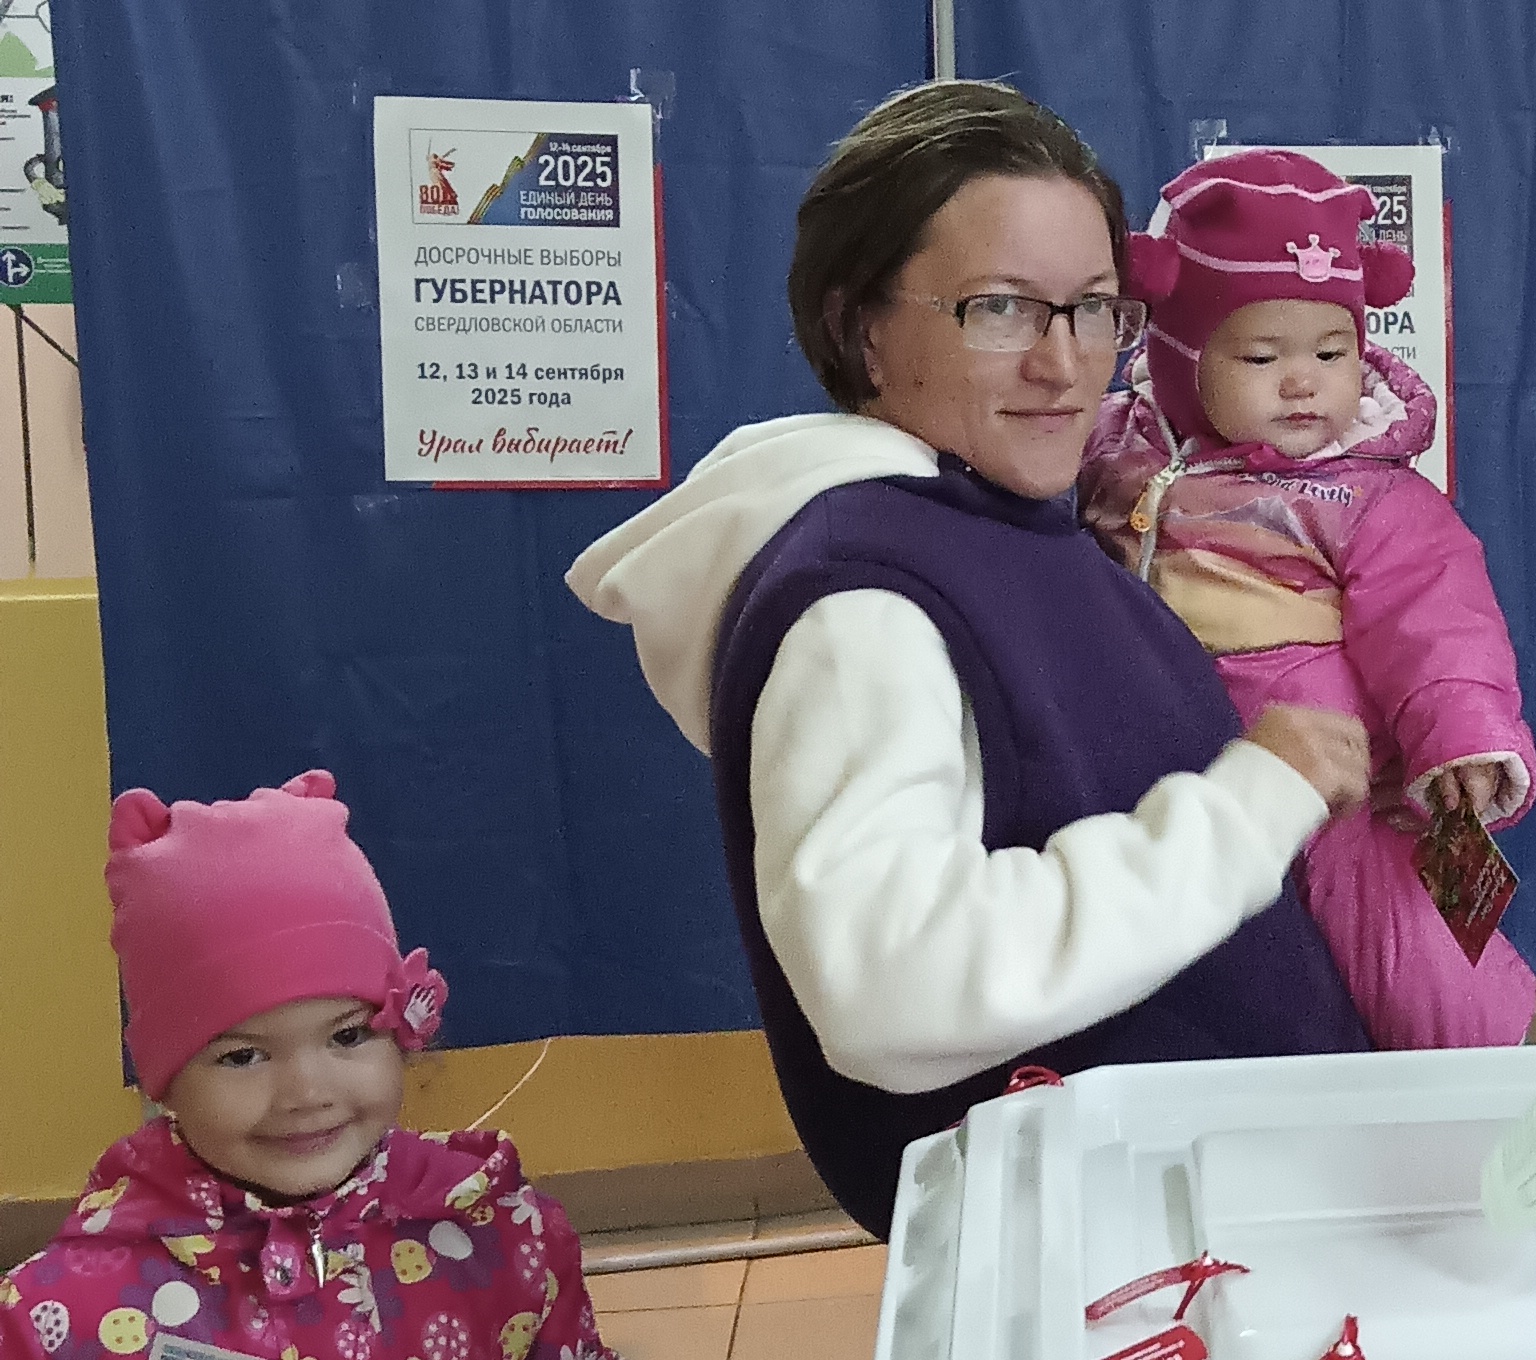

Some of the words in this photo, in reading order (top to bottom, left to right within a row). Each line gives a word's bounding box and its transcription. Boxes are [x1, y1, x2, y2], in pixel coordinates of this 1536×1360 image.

[538, 155, 612, 187] 2025
[520, 189, 575, 205] ЕДИНЫЙ
[577, 191, 613, 207] ДЕНЬ
[414, 246, 533, 268] ДОСРОЧНЫЕ
[540, 249, 622, 267] ВЫБОРЫ
[414, 278, 622, 306] ГУБЕРНАТОРА
[414, 315, 545, 335] СВЕРДЛОВСКОЙ
[551, 318, 623, 334] ОБЛАСТИ
[417, 362, 447, 381] 12,
[456, 363, 478, 380] 13
[486, 366, 497, 380] и
[505, 365, 528, 380] 14
[535, 364, 624, 384] сентября
[471, 388, 521, 405] 2025
[529, 391, 571, 407] года
[418, 428, 483, 462] Урал
[492, 427, 633, 462] выбирает!
